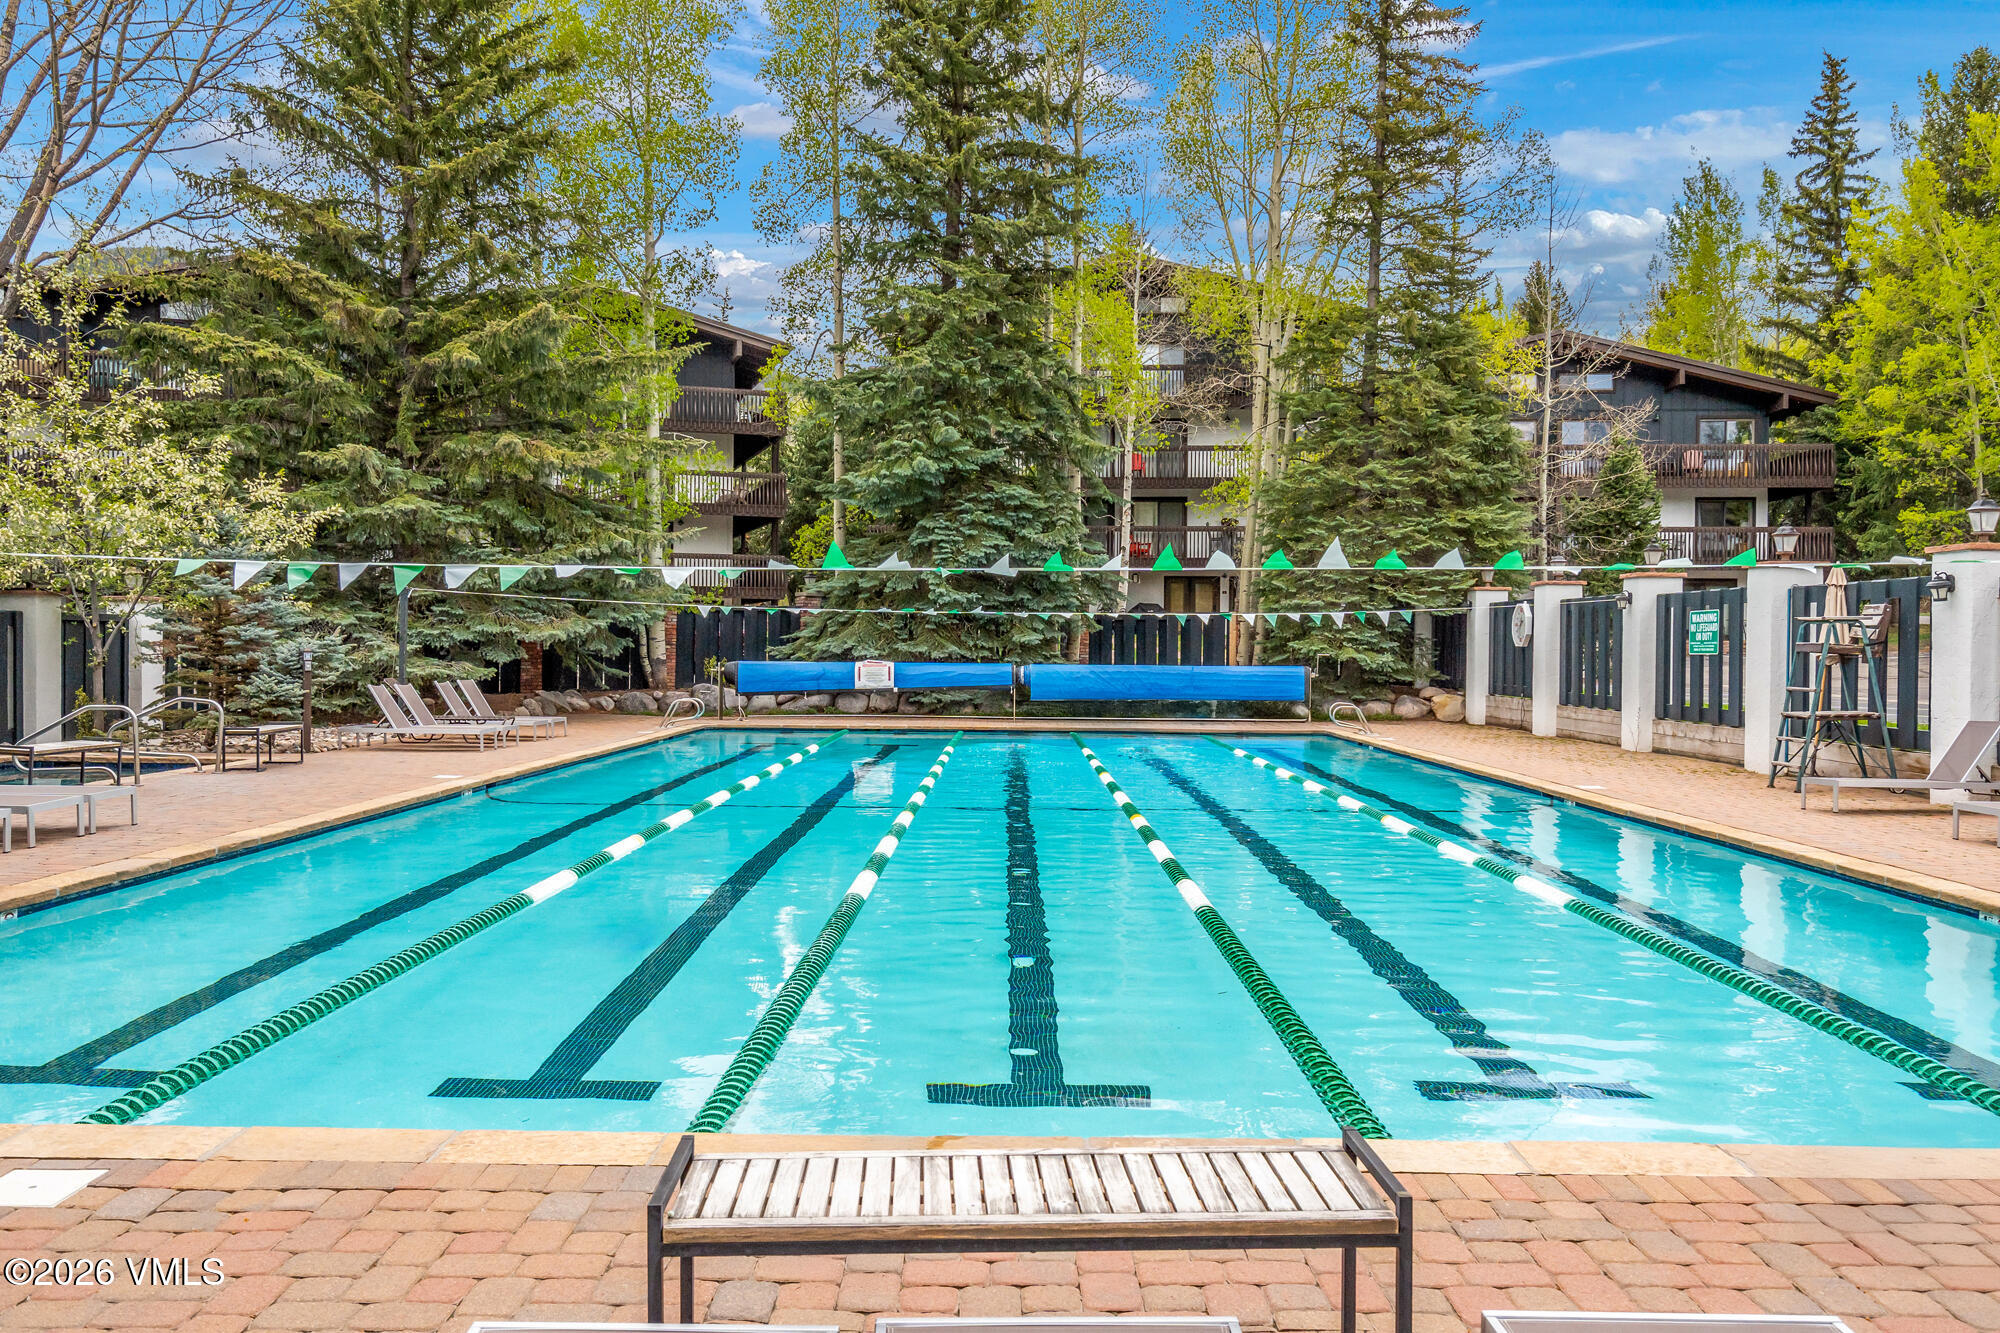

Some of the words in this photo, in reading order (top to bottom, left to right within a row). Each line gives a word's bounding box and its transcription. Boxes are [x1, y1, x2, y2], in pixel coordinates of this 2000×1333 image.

[1692, 613, 1717, 623] WARNING
[1691, 624, 1697, 632] NO
[1697, 623, 1718, 631] LIFEGUARD
[1696, 633, 1701, 641] ON
[1702, 632, 1712, 640] DUTY
